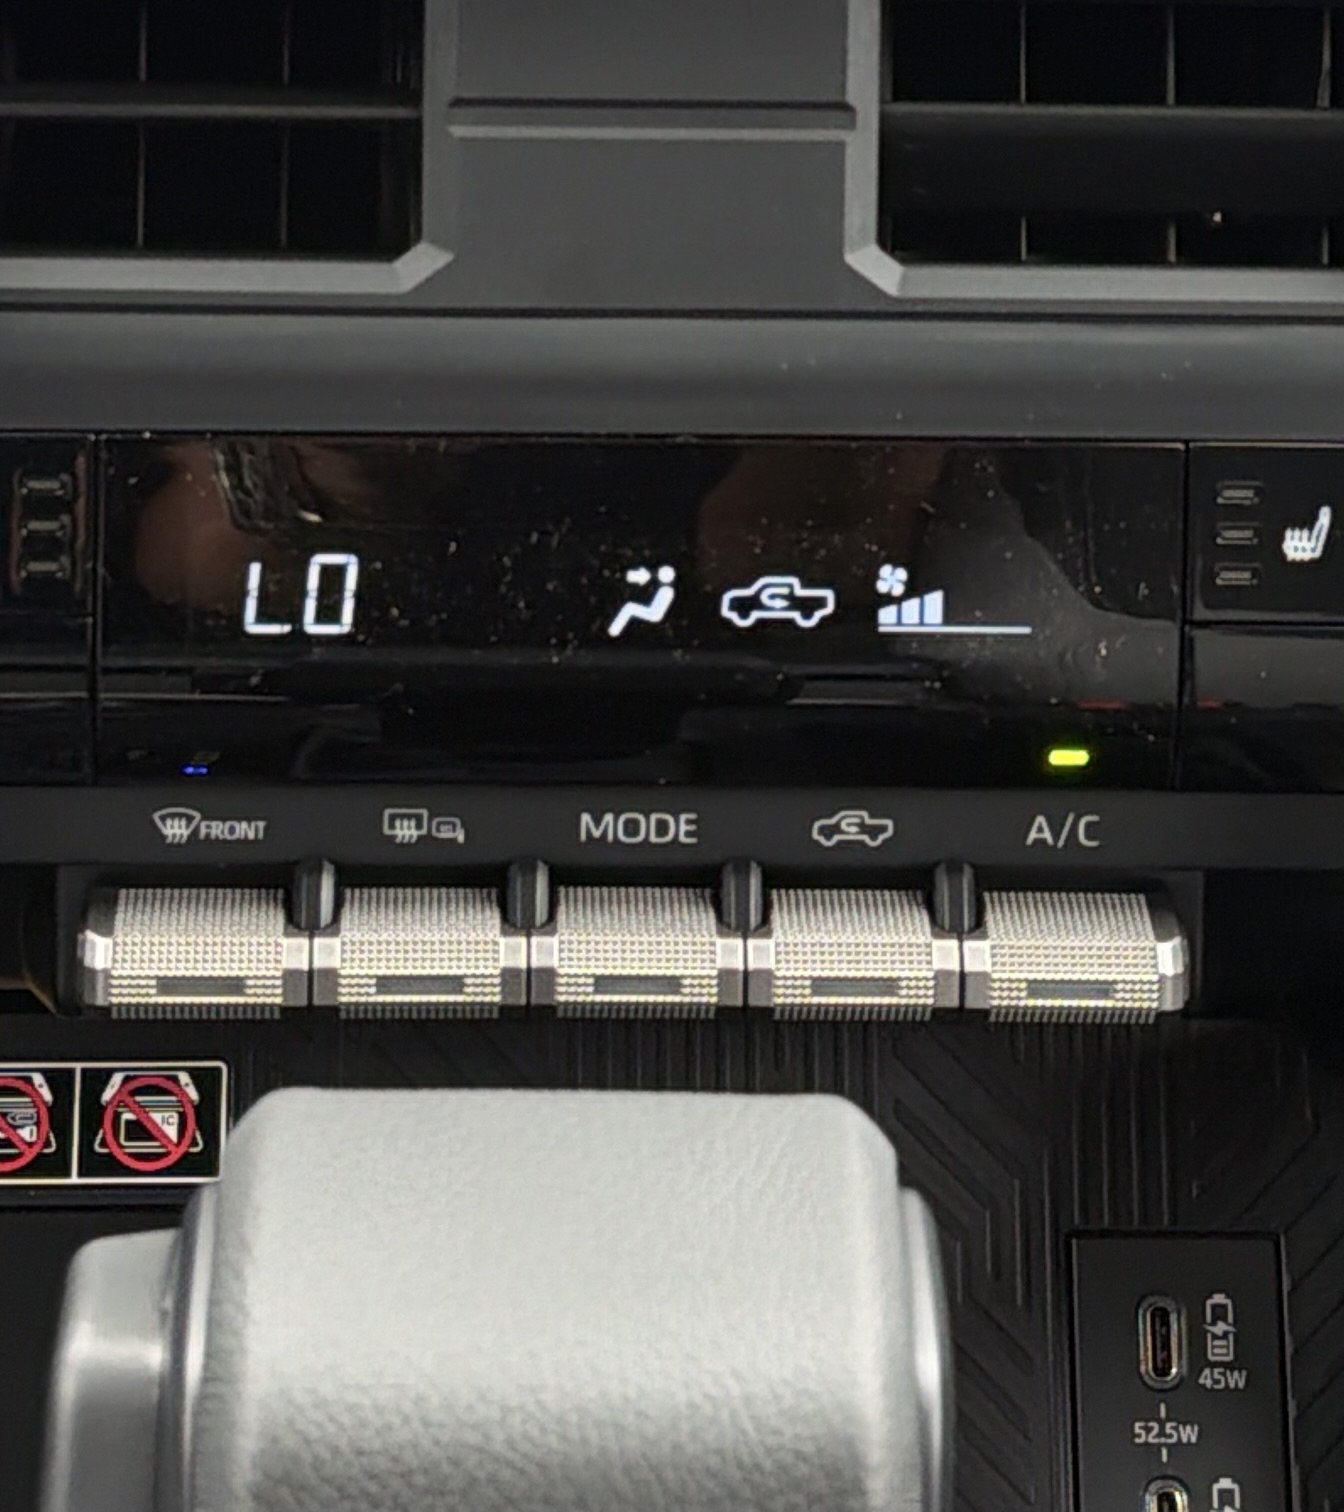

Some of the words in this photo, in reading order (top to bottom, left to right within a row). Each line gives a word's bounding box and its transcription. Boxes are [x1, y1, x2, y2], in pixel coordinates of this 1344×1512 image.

[242, 552, 360, 636] LO
[199, 819, 267, 843] FRONT
[579, 811, 699, 844] MODE
[1025, 813, 1101, 848] A/C
[161, 1114, 177, 1127] IC
[1198, 1367, 1248, 1390] 45W
[1132, 1420, 1199, 1444] 52.5W
